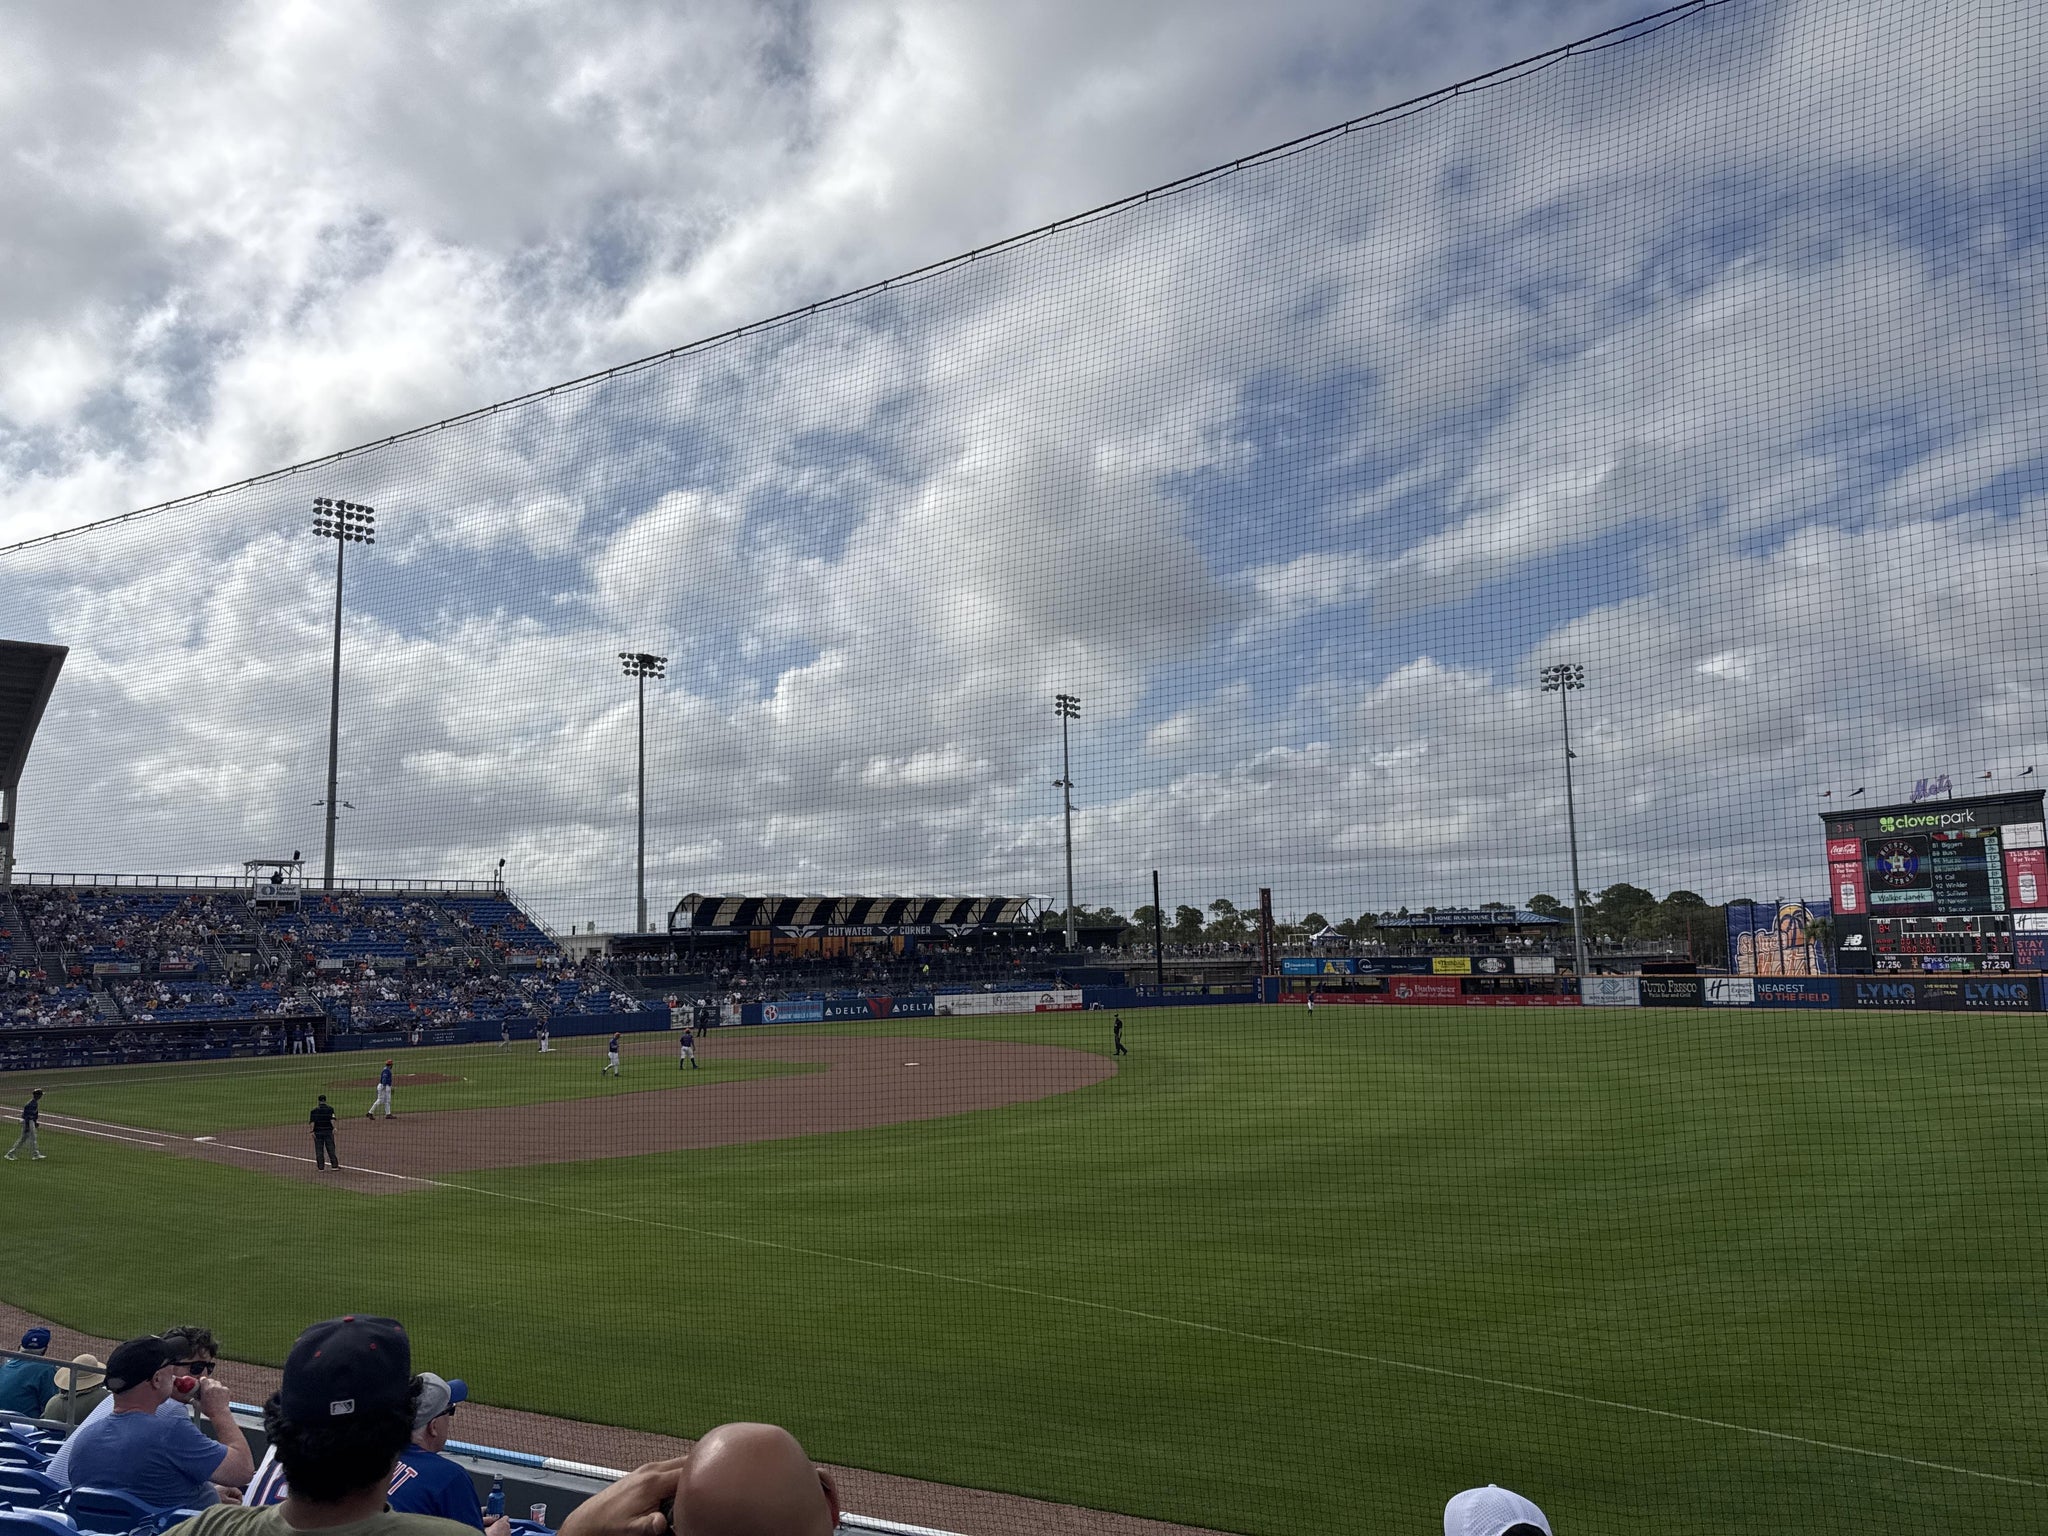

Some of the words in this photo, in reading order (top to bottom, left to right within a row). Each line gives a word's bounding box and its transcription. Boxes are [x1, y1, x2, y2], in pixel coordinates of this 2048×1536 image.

[1909, 774, 1952, 801] Mets
[1878, 894, 1902, 902] Walker
[1903, 893, 1926, 901] Janek
[827, 926, 873, 936] CUTWATER
[900, 926, 931, 935] CORNER
[2016, 940, 2043, 948] STAY
[2017, 948, 2045, 956] WITH
[1923, 955, 1943, 964] Bryce
[1876, 960, 1901, 969] $7,250
[1981, 960, 2010, 969] $7,250
[1414, 985, 1456, 993] Budweiser
[1641, 980, 1666, 992] TUTTO
[1667, 980, 1697, 992] FRESCO
[1757, 984, 1804, 992] NEAREST
[1758, 993, 1773, 1001] TO
[1775, 993, 1796, 1001] THE
[1798, 993, 1830, 1002] FIELD
[835, 1006, 869, 1015] DELTA
[902, 1002, 934, 1011] DELTA
